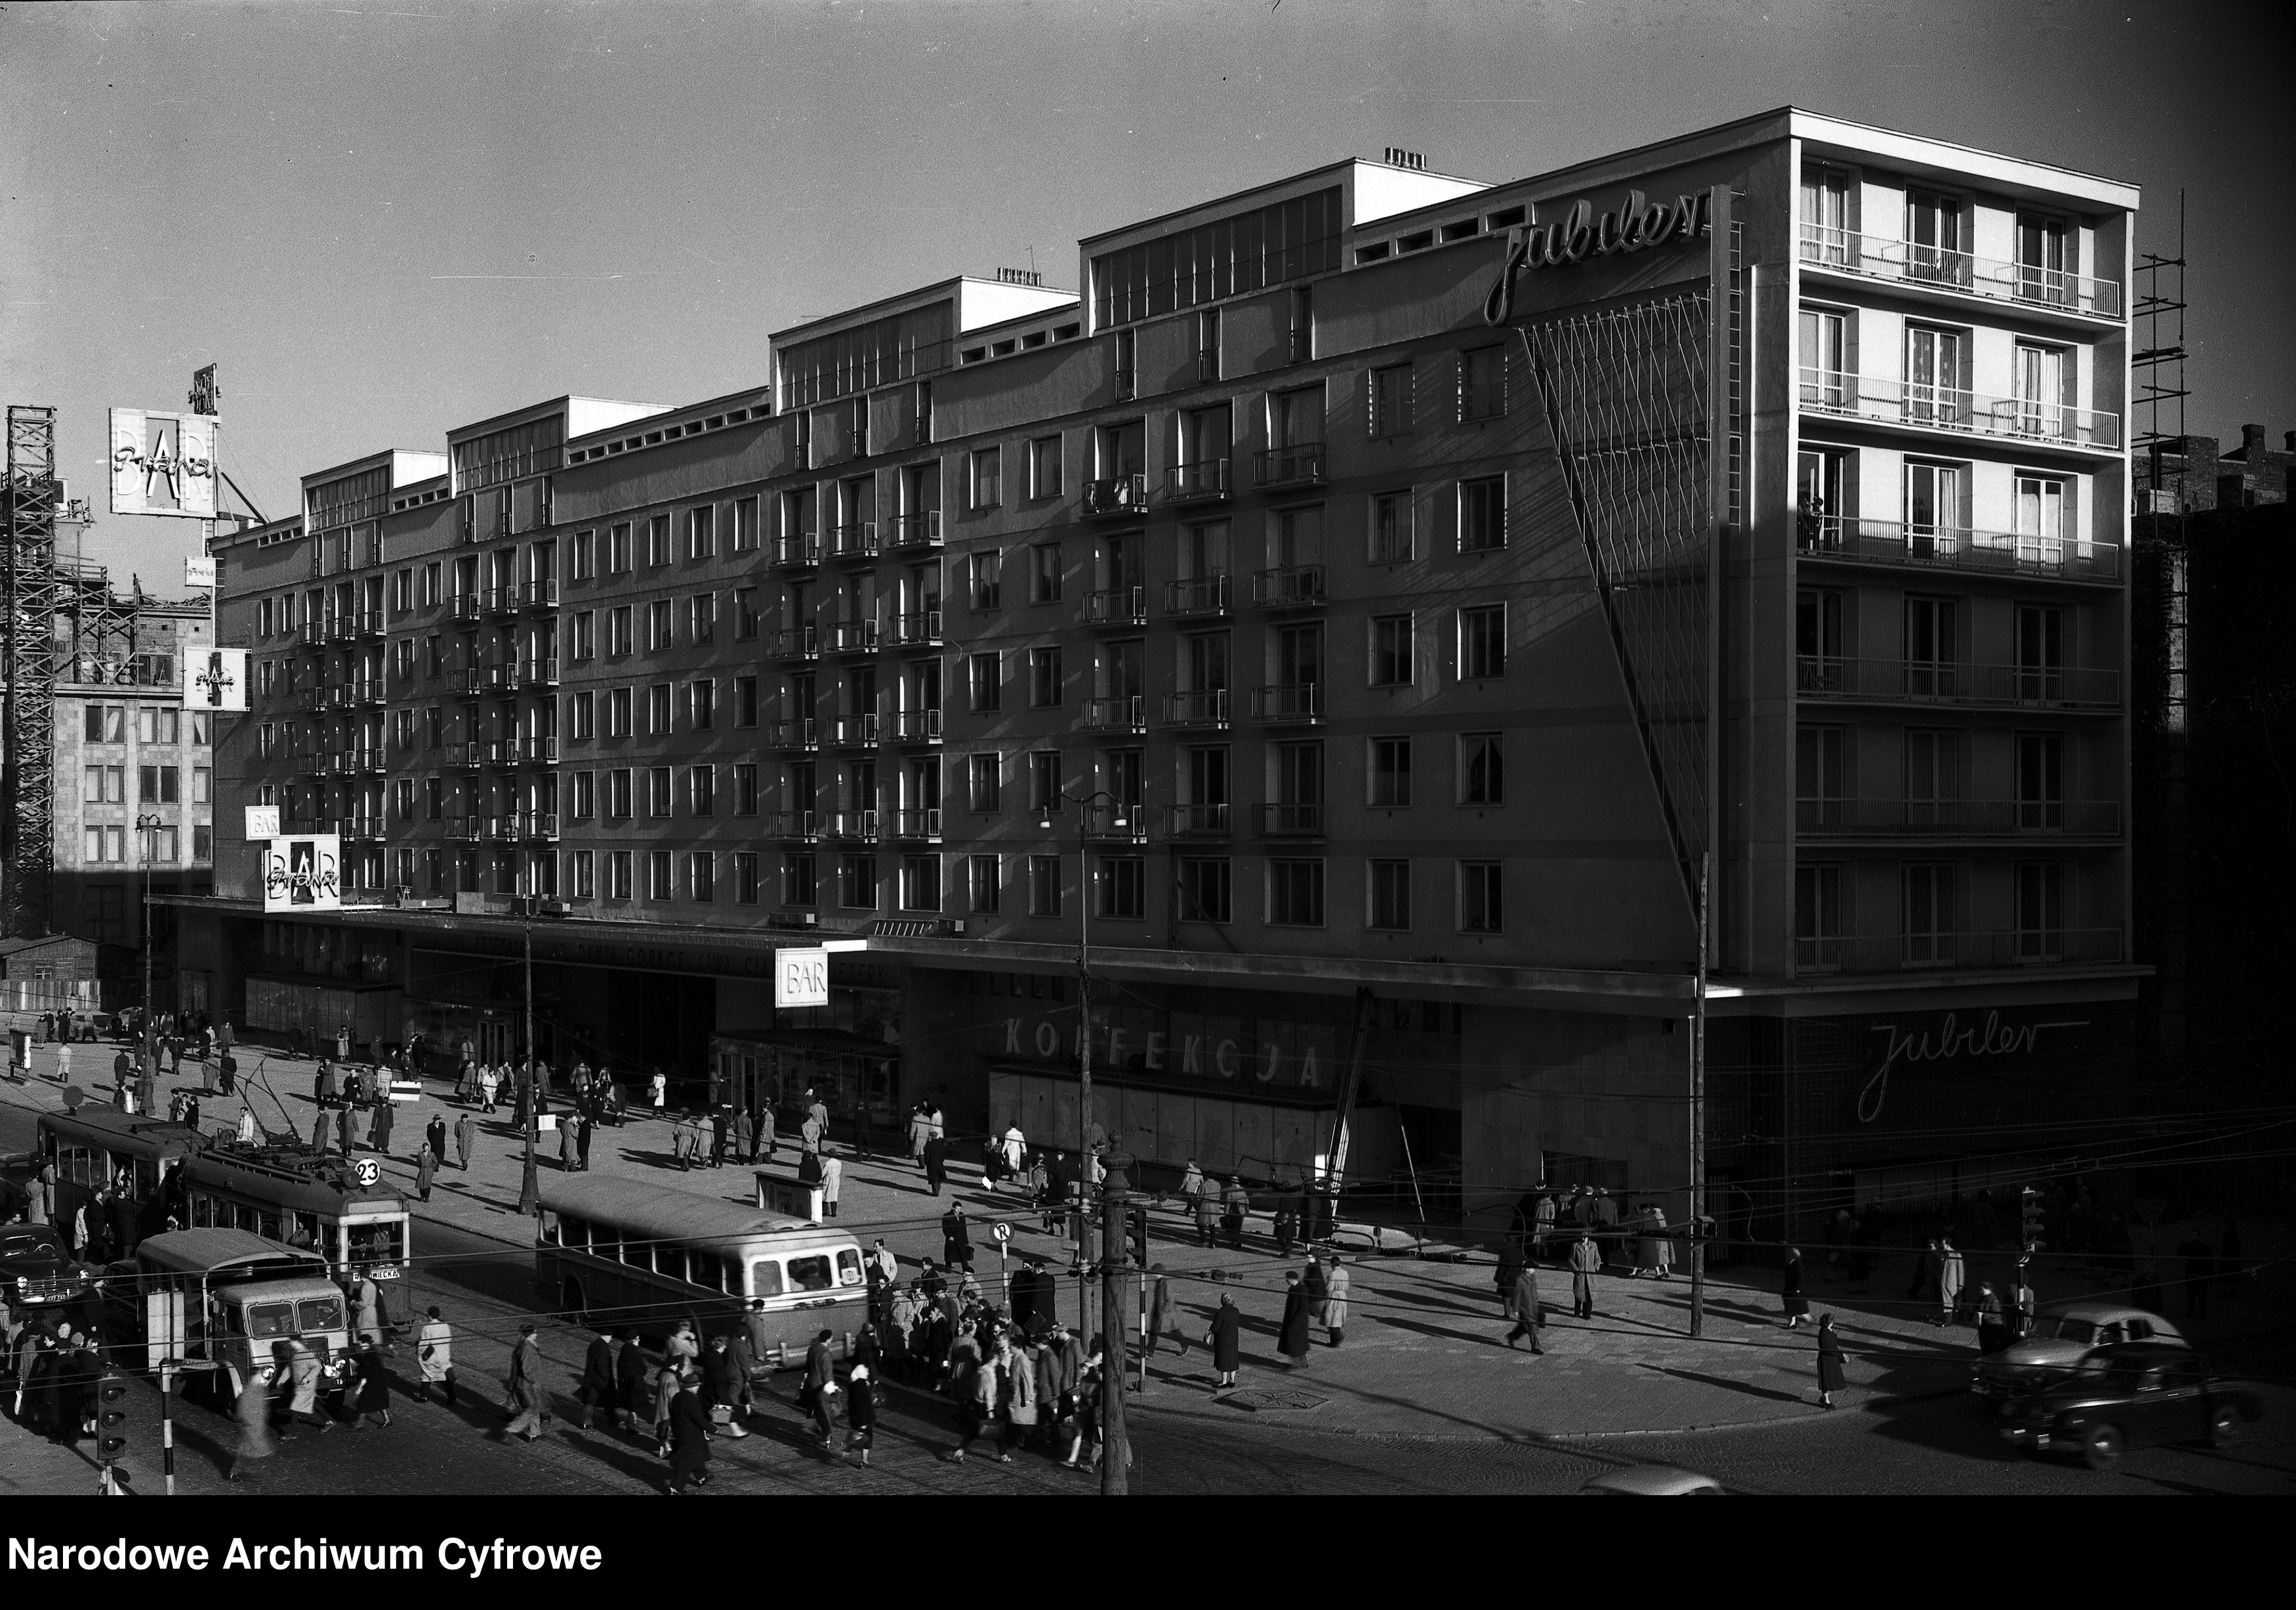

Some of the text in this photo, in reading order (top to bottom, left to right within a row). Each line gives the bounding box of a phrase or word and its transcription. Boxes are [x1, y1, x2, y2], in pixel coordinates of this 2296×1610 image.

[116, 427, 209, 501] BAR
[254, 814, 278, 833] BAR
[269, 851, 338, 899] BAR
[697, 953, 730, 972] KAWA
[787, 962, 826, 993] BAR
[357, 1163, 379, 1182] 23
